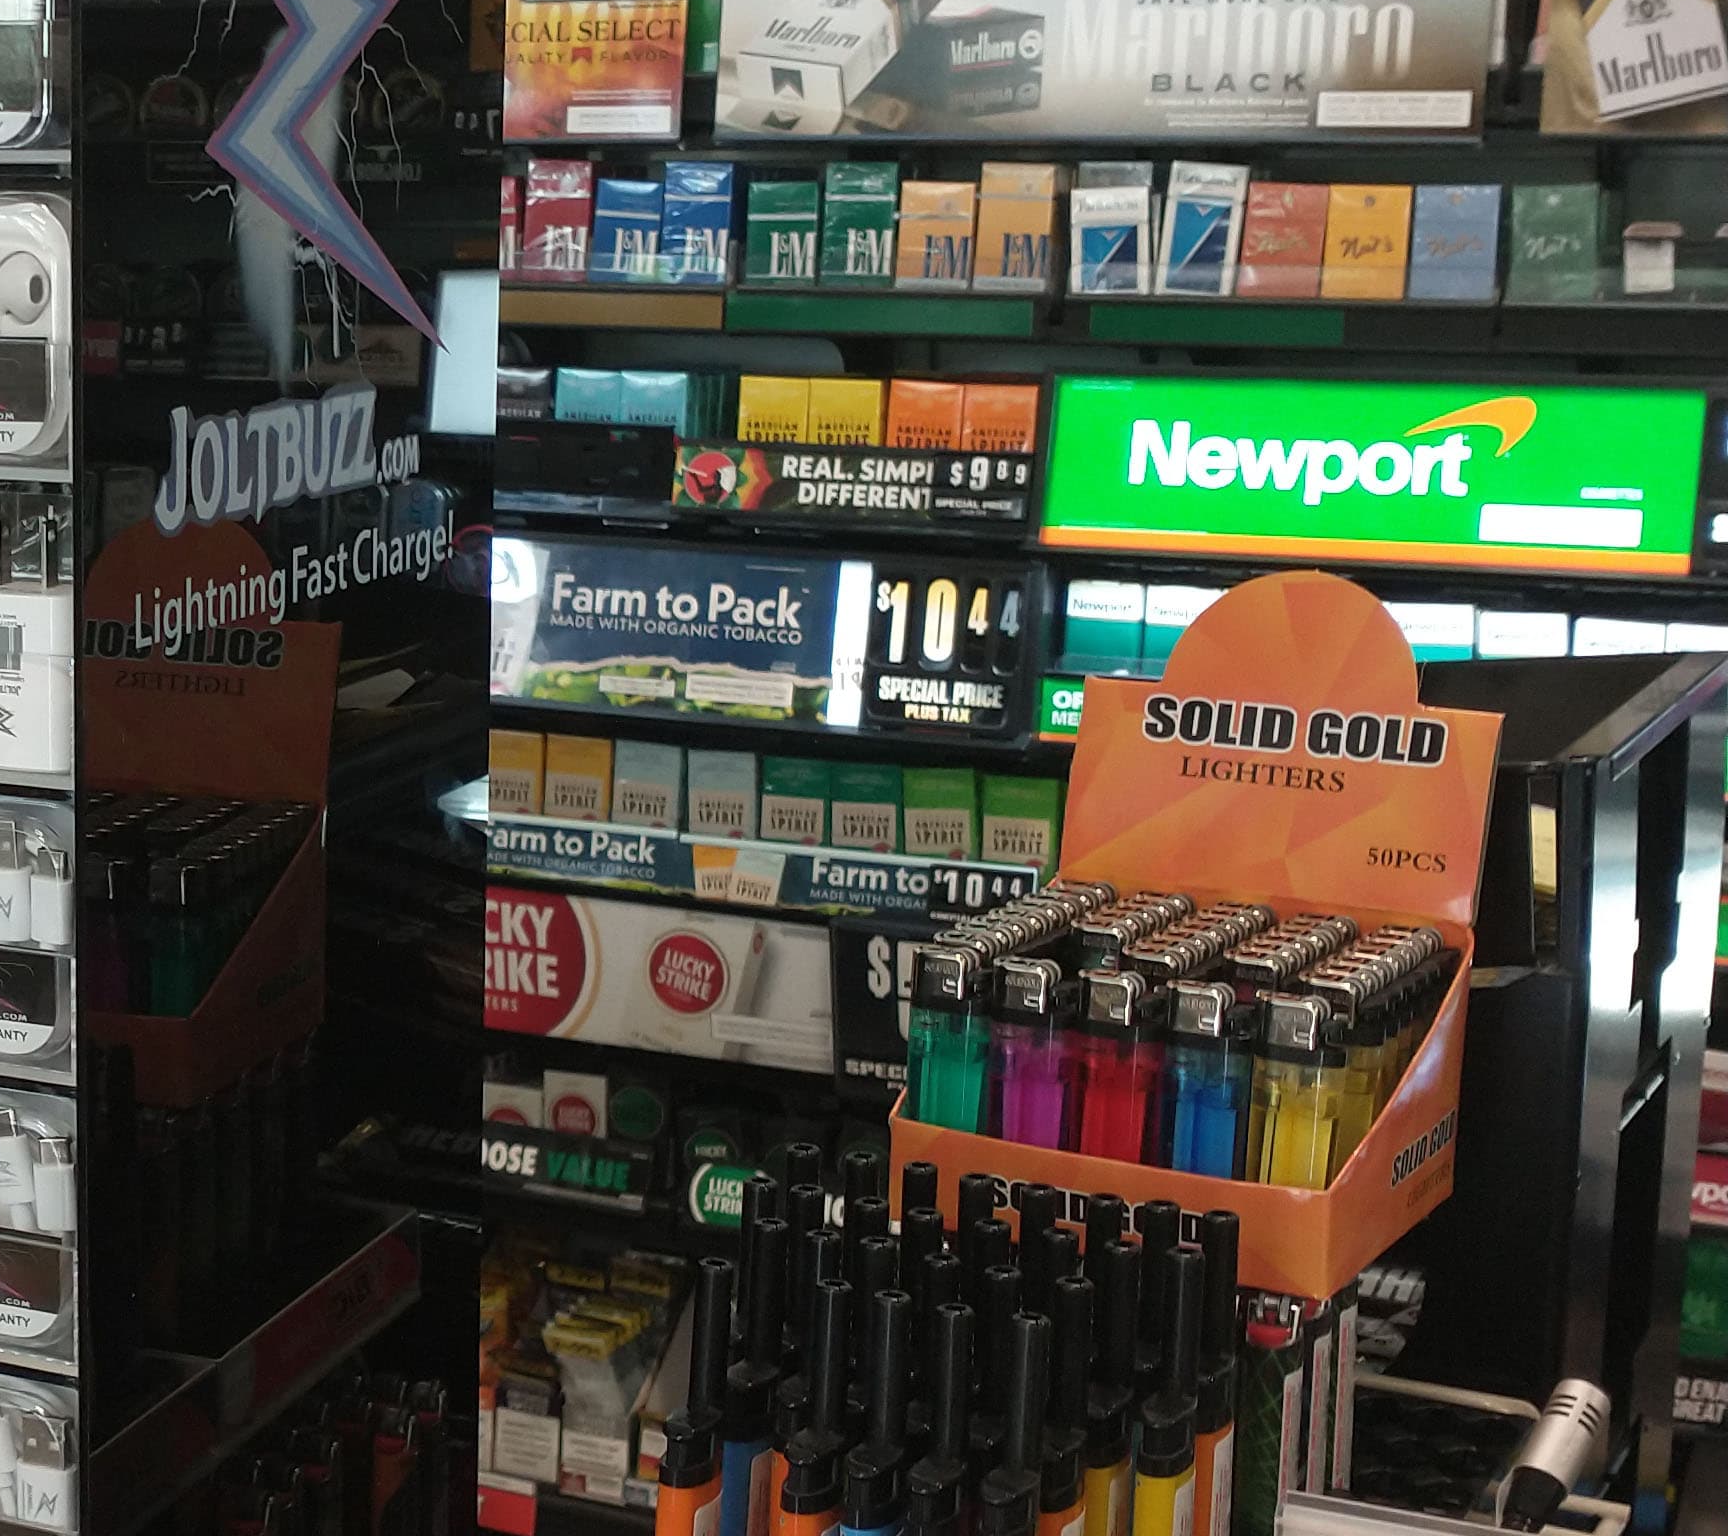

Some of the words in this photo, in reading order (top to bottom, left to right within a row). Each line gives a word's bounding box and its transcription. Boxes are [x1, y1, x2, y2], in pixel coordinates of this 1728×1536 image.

[577, 19, 680, 42] SELECT
[764, 16, 863, 53] Marlboro
[1598, 33, 1724, 97] Marlboro
[1150, 72, 1308, 93] BLACK
[154, 386, 378, 532] JOLTBUZZ
[782, 455, 853, 480] REAL.
[1128, 420, 1472, 506] Newport
[134, 565, 287, 655] Lightning
[290, 543, 349, 607] Fast
[350, 510, 454, 585] Charge!
[551, 573, 648, 617] Farm
[656, 586, 699, 619] to
[708, 583, 802, 628] Pack
[550, 614, 593, 632] MADE
[596, 617, 632, 634] WITH
[636, 619, 719, 639] ORGANIC
[724, 625, 803, 646] TOBACCO
[879, 676, 951, 705] SPECIAL
[953, 680, 1003, 709] PRICE
[904, 703, 937, 720] PLUS
[939, 704, 969, 723] TAX
[1144, 695, 1298, 753] SOLID
[1306, 706, 1449, 767] GOLD
[1181, 756, 1346, 794] LIGHTERS
[1367, 847, 1447, 873] 50PCS
[664, 947, 715, 978] LUCKY
[656, 967, 712, 1001] STRIKE
